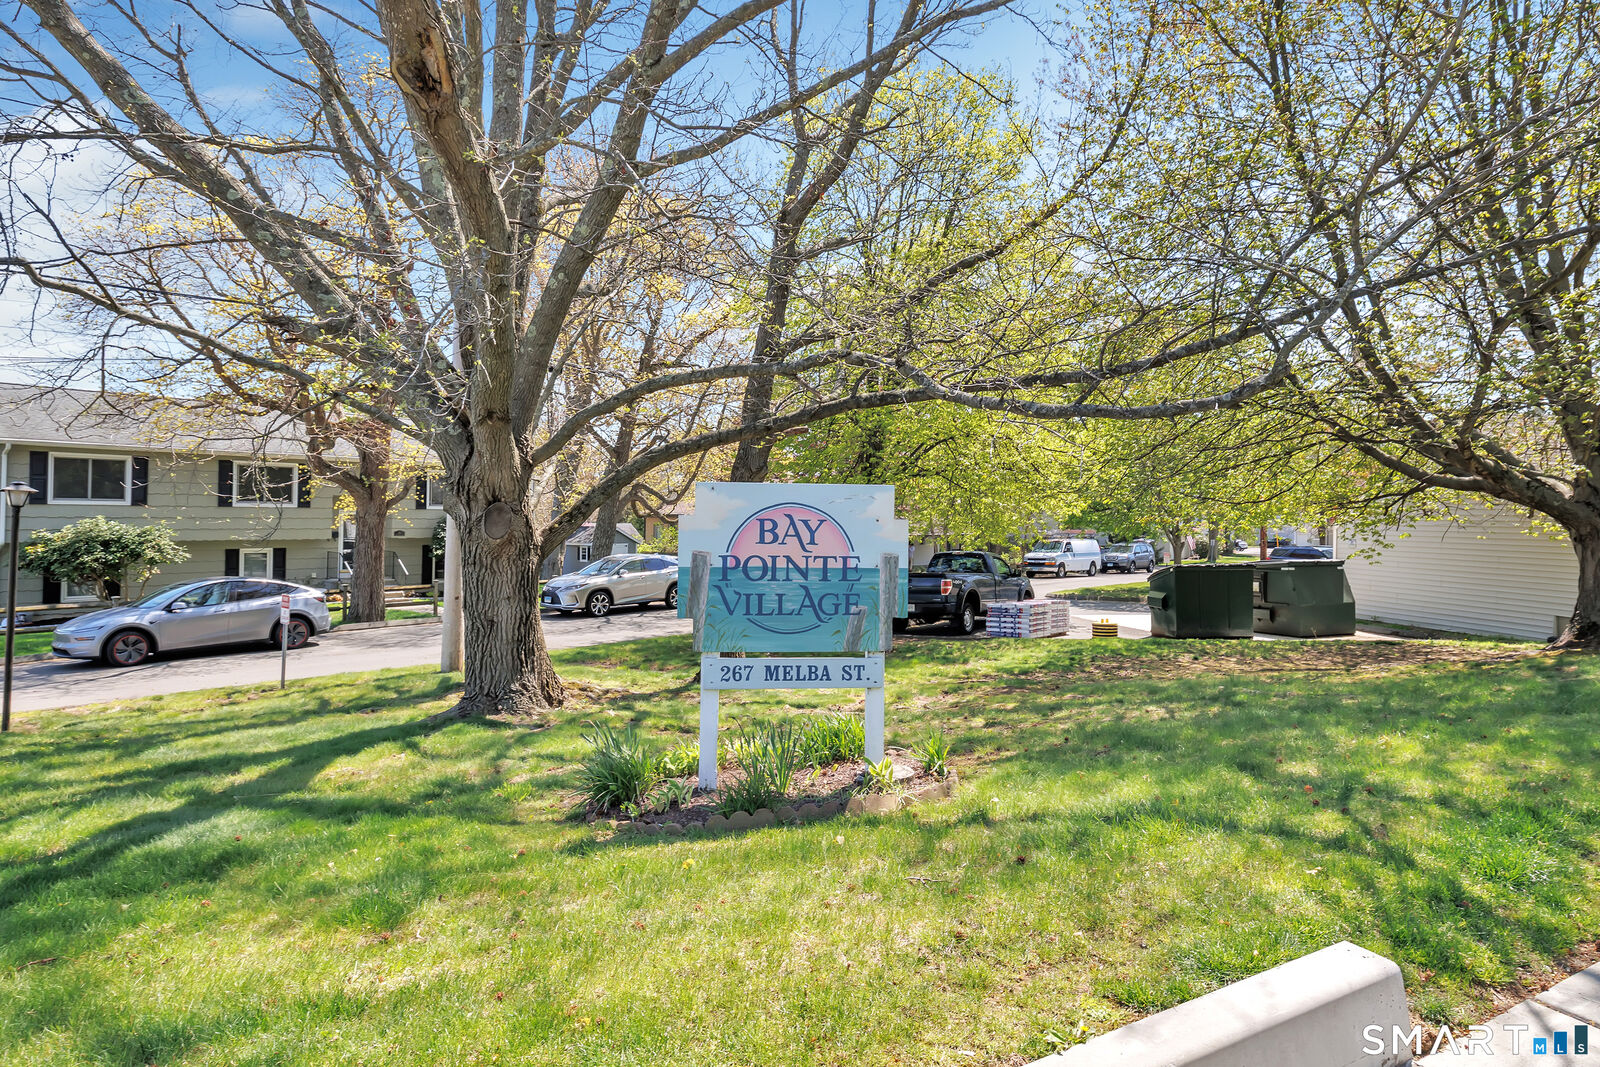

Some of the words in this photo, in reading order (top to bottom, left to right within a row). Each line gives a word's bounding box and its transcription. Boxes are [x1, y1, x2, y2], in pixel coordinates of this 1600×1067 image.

[755, 513, 828, 553] BAY
[718, 554, 863, 582] POINTE
[711, 584, 863, 623] VILLAGE
[720, 665, 754, 682] 267
[764, 665, 832, 681] MELBA
[841, 664, 870, 681] ST.
